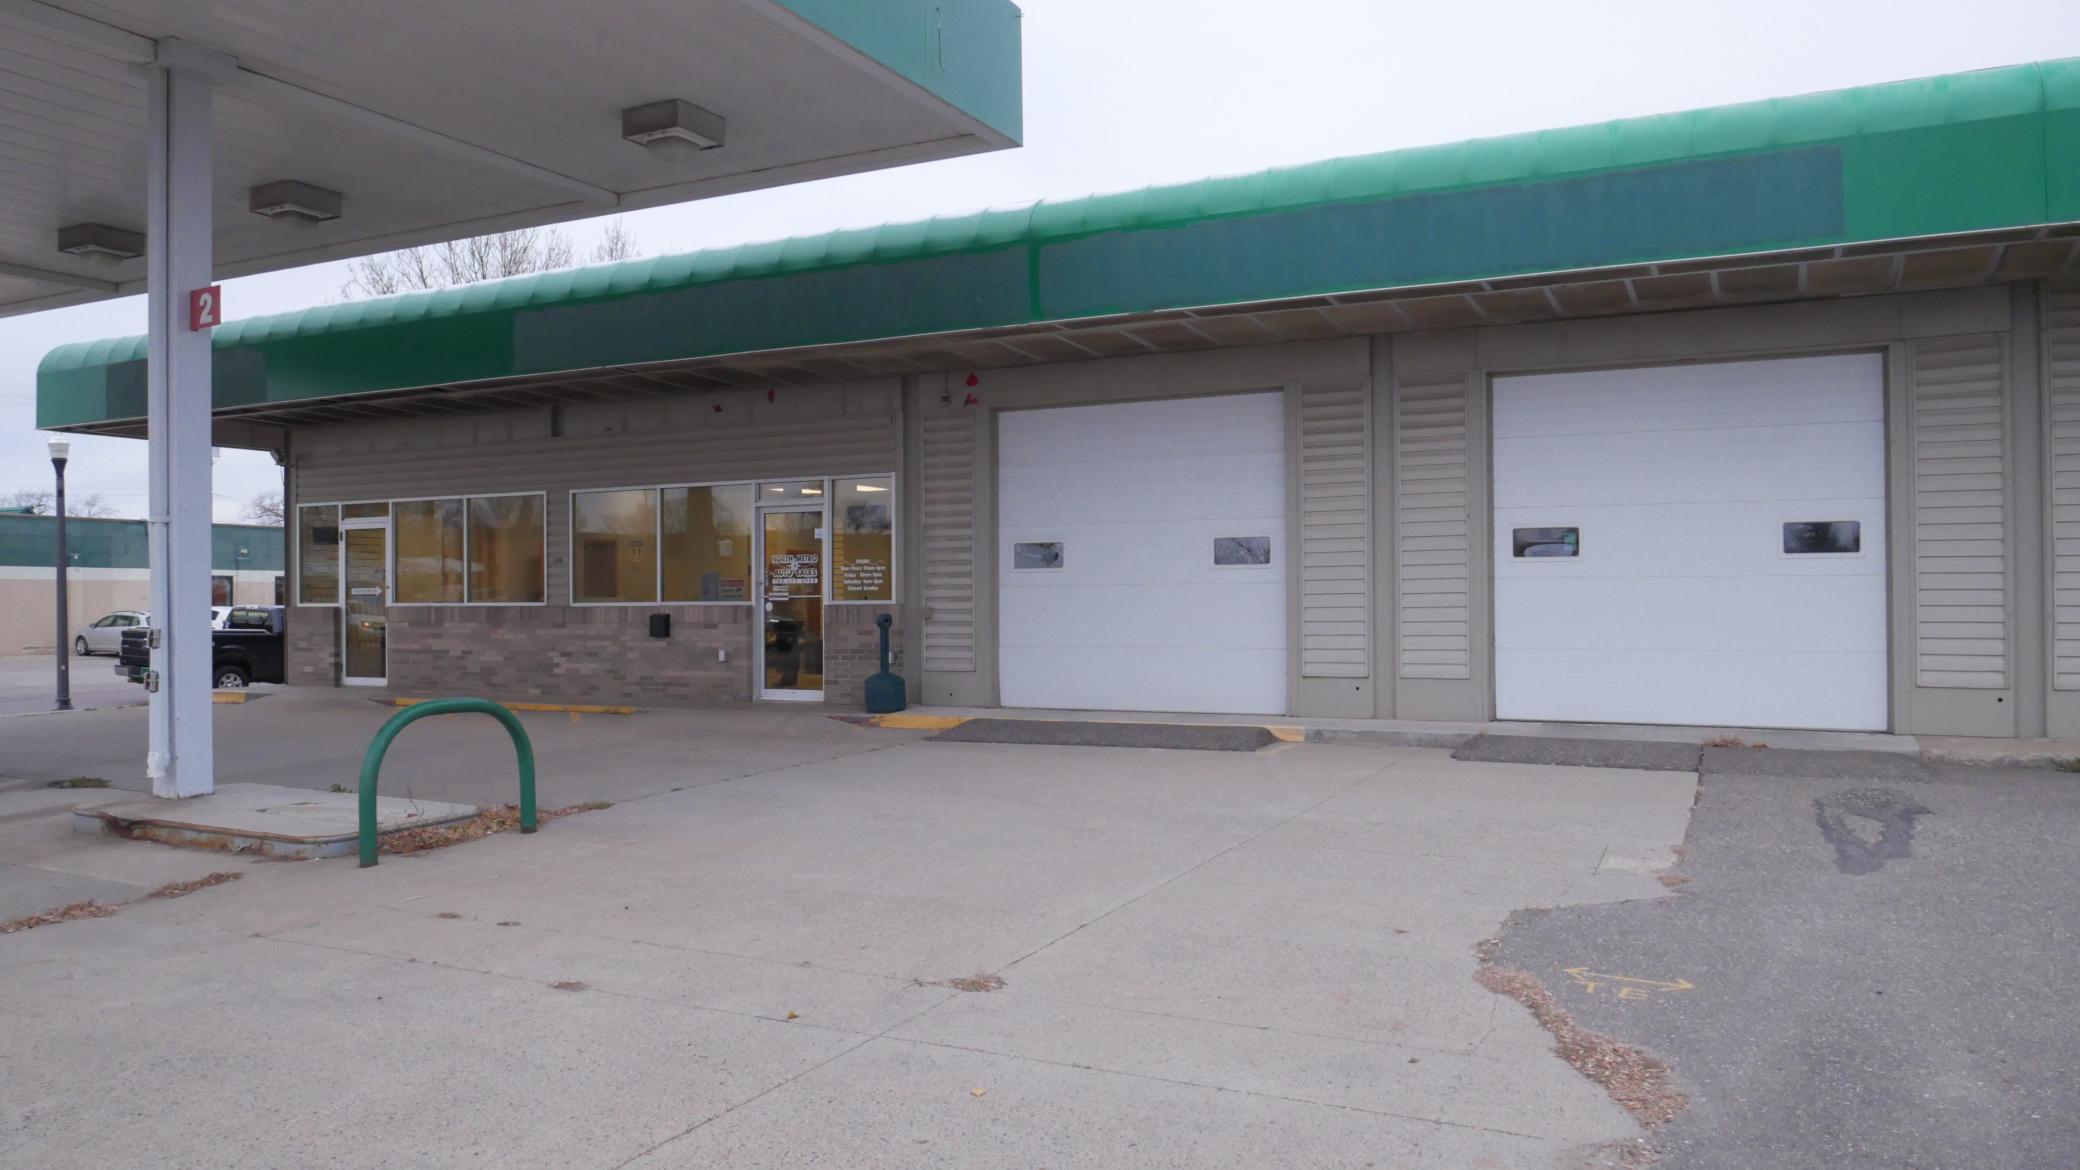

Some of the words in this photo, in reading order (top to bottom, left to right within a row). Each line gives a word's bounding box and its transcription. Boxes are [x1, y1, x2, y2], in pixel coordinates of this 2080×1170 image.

[199, 292, 213, 325] 2
[772, 554, 794, 564] NORTH
[796, 554, 819, 563] METRO
[774, 568, 794, 577] AUTO
[795, 568, 818, 577] SALES
